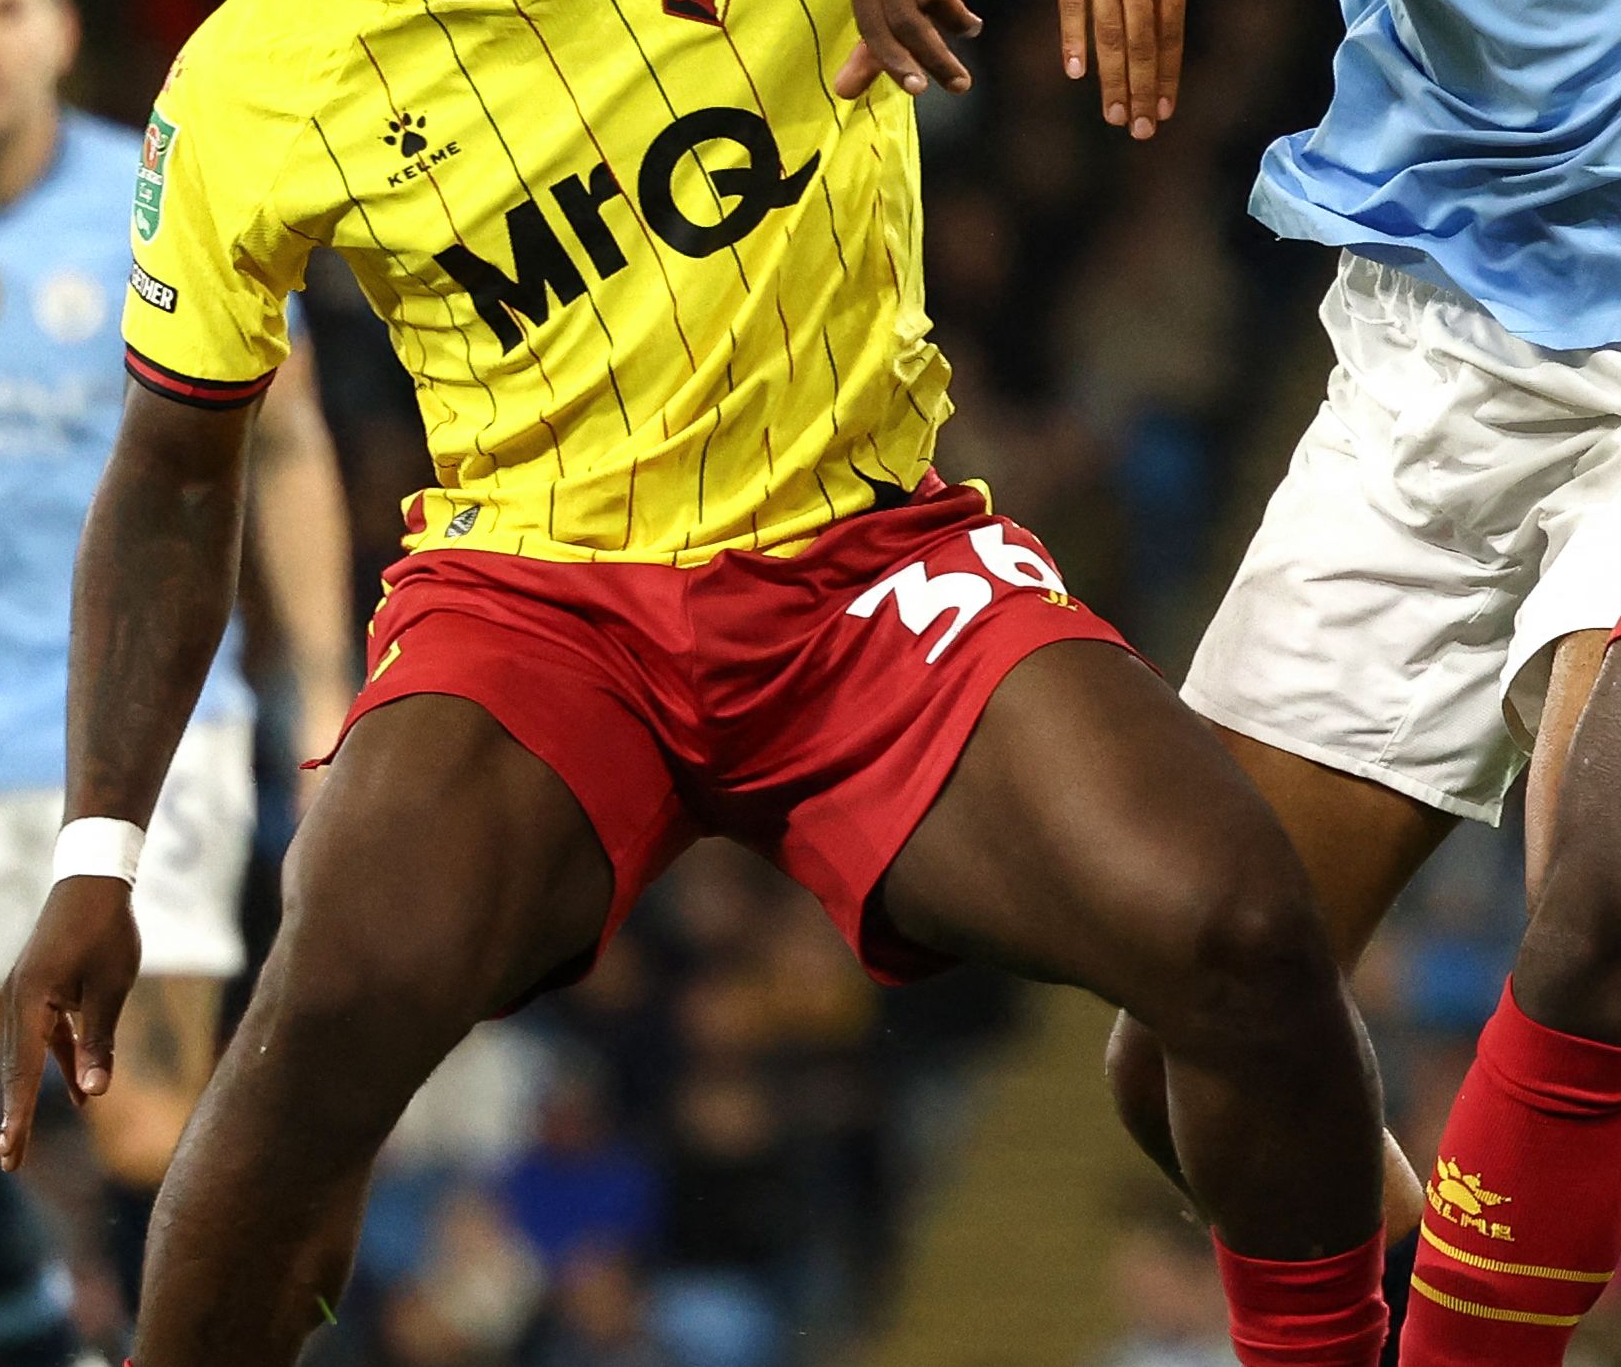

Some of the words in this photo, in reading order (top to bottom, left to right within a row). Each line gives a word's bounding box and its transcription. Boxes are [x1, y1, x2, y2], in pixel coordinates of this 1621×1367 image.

[387, 140, 462, 188] KELME
[434, 106, 821, 357] MrQ
[846, 522, 1069, 665] 36
